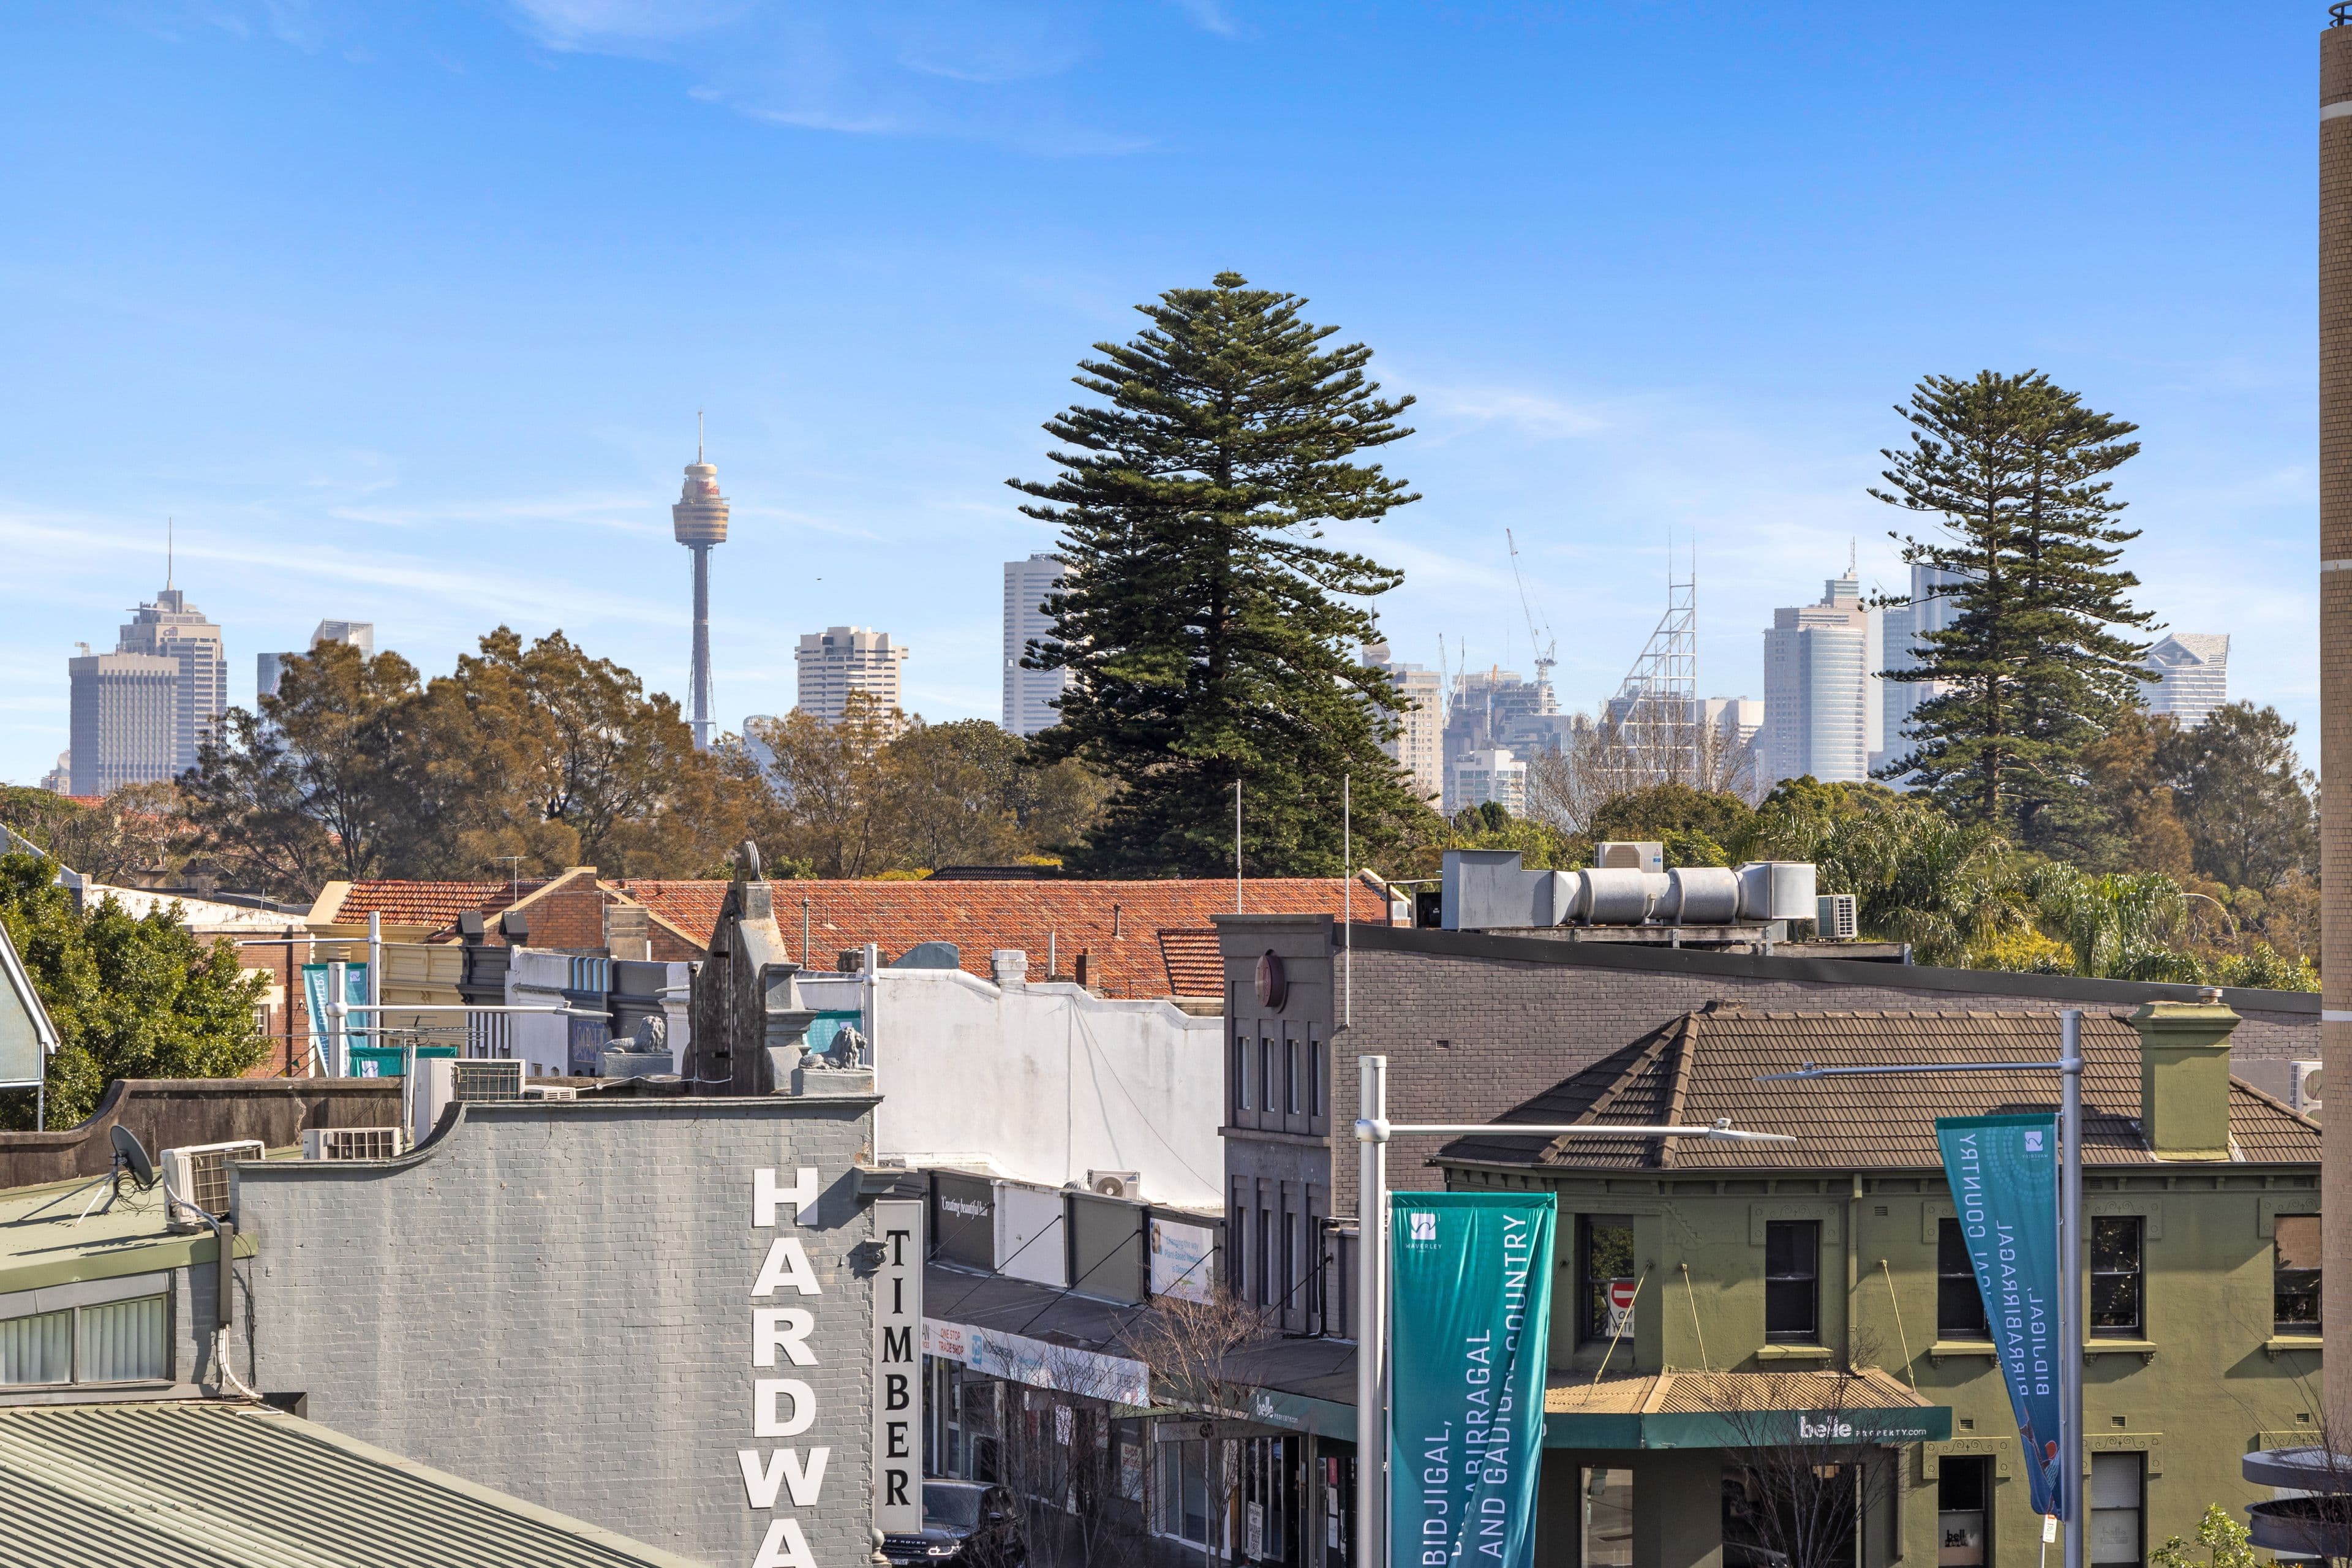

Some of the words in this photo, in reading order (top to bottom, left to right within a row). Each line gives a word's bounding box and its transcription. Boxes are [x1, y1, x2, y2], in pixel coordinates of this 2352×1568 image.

[960, 1198, 979, 1219] beautiful
[737, 1167, 831, 1568] HARDWA
[881, 1229, 913, 1506] TIMBER
[950, 1330, 960, 1341] STOP
[1483, 1358, 1515, 1484] GADIG
[1422, 1421, 1452, 1566] BIDJIGAL,
[1479, 1498, 1506, 1558] AND
